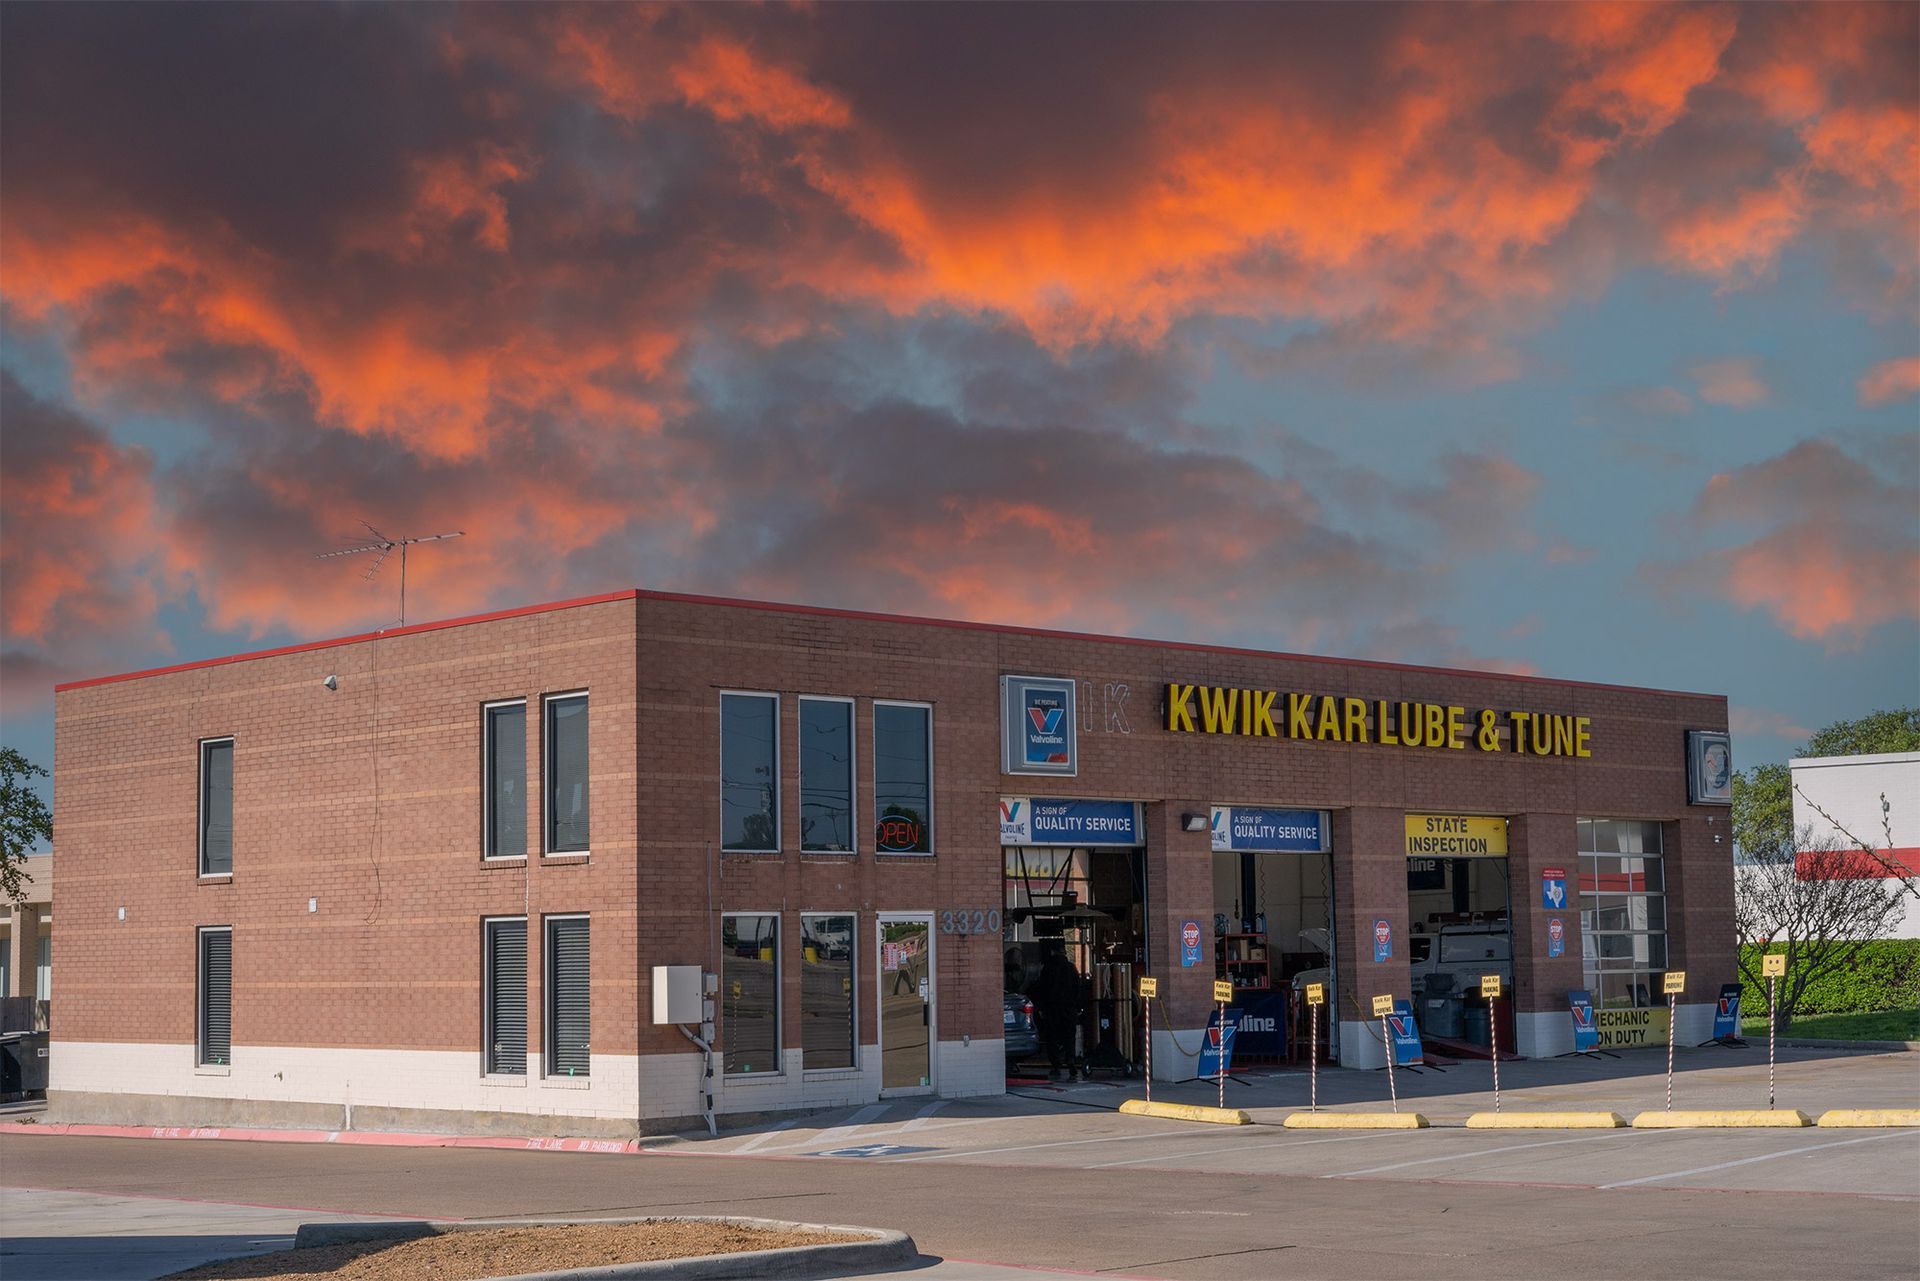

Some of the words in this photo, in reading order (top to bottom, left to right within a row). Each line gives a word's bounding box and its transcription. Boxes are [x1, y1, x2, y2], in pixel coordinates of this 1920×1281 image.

[1167, 683, 1278, 737] KWIK
[1286, 693, 1368, 743] KAR
[1376, 700, 1465, 748] LUBE
[1475, 709, 1501, 752] &
[1509, 711, 1592, 758] TUNE
[1030, 734, 1064, 744] Valvoline
[1036, 807, 1040, 815] A
[1042, 807, 1058, 815] SIGN
[1058, 807, 1068, 815] OF
[1035, 816, 1083, 830] QUALITY
[1086, 818, 1131, 832] SERVICE
[1234, 816, 1240, 824] A
[1240, 816, 1254, 824] SIGN
[1254, 816, 1262, 824] OF
[1426, 818, 1468, 833] STATE
[876, 822, 919, 844] OPEN
[1234, 826, 1276, 838] QUALITY
[1278, 826, 1318, 840] SERVICE
[1409, 836, 1487, 854] INSPECTION
[1407, 858, 1436, 872] line
[942, 909, 1000, 934] 3320
[1183, 930, 1199, 939] STOP
[1376, 928, 1390, 936] STOP
[1215, 991, 1230, 999] PARKING
[1375, 1006, 1392, 1014] PARKING
[1599, 1032, 1612, 1045] ON
[1616, 1030, 1646, 1044] DUTY
[544, 1139, 565, 1150] LANE
[578, 1140, 590, 1150] NO
